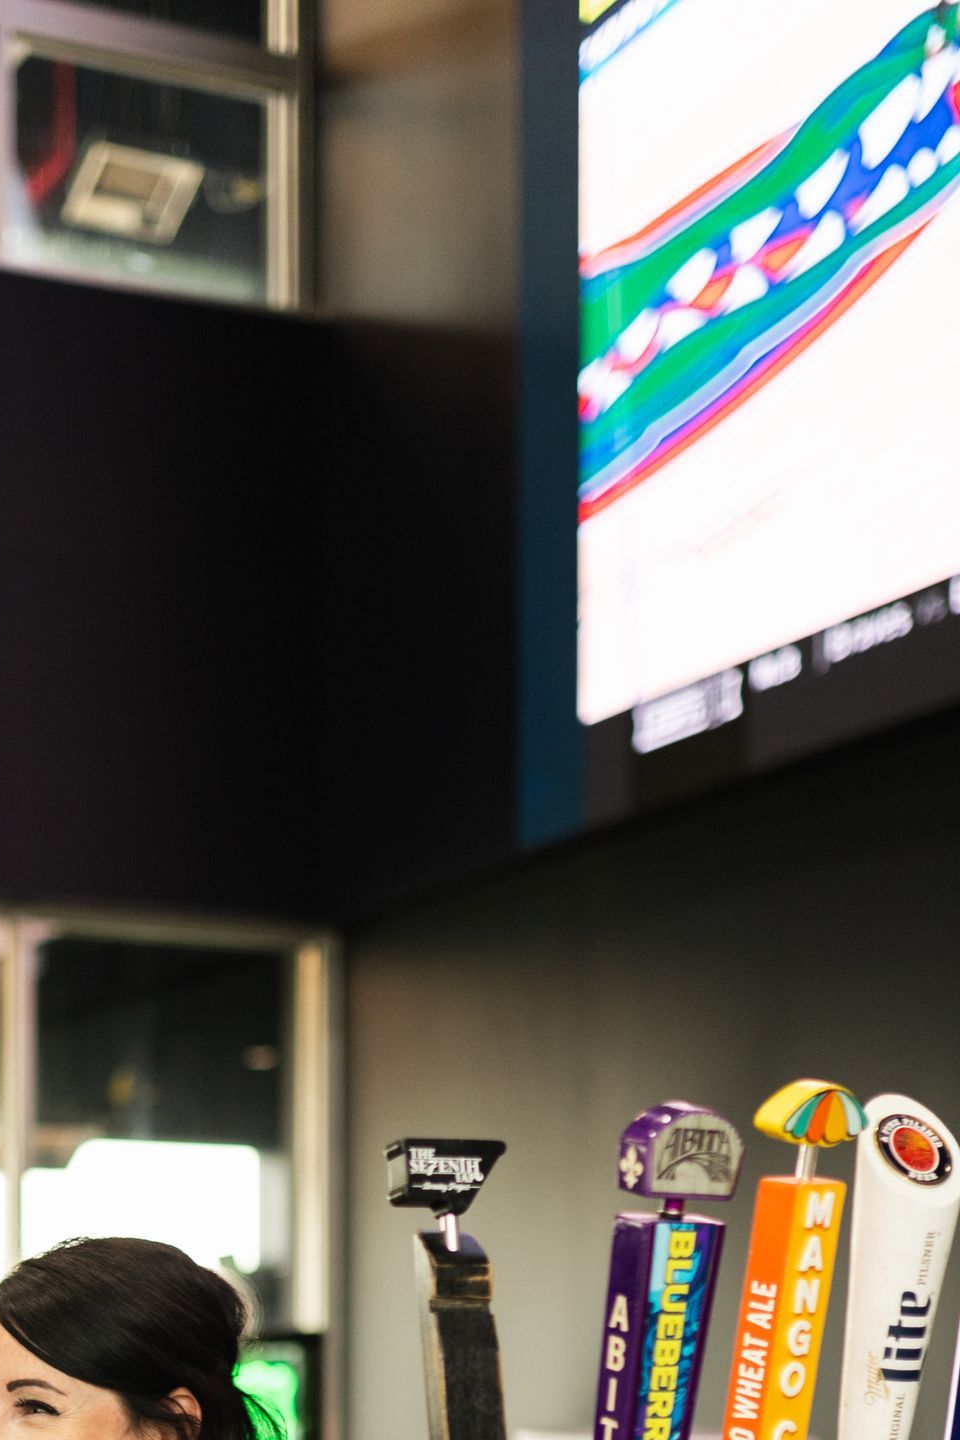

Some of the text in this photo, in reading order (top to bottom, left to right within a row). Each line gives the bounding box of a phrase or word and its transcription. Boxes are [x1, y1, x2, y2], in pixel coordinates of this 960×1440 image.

[409, 1146, 436, 1161] THE
[657, 1127, 731, 1173] ABITA
[901, 1117, 944, 1149] PILSNER
[908, 1171, 938, 1182] BEER
[916, 1230, 936, 1286] PILSNER
[746, 1280, 778, 1331] ALE
[779, 1191, 836, 1399] MANGO
[879, 1290, 932, 1382] lite
[732, 1332, 770, 1420] WHEAT
